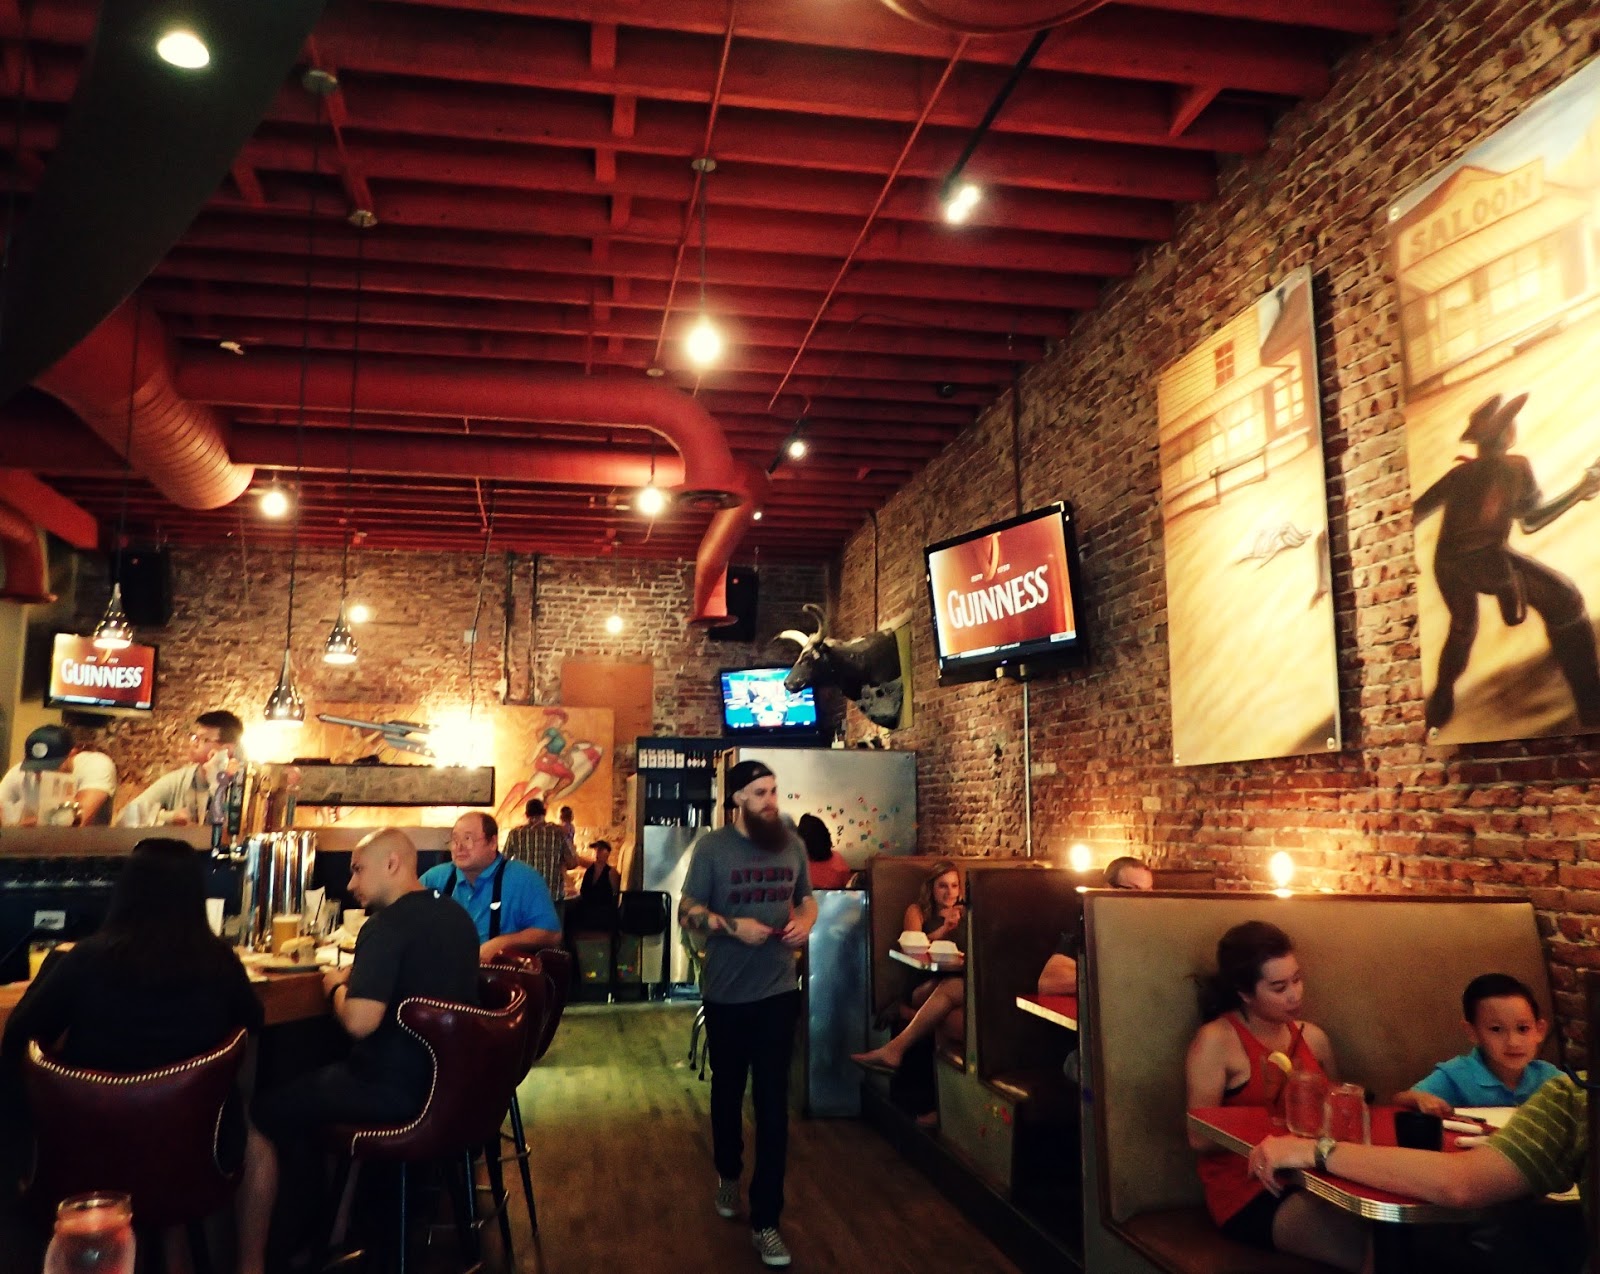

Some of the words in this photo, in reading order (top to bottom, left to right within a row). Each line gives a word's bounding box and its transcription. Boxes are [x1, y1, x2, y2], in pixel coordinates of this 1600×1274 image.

[1410, 172, 1533, 258] SALOON
[947, 564, 1049, 629] GUINNESS
[61, 658, 144, 688] GUINNESS
